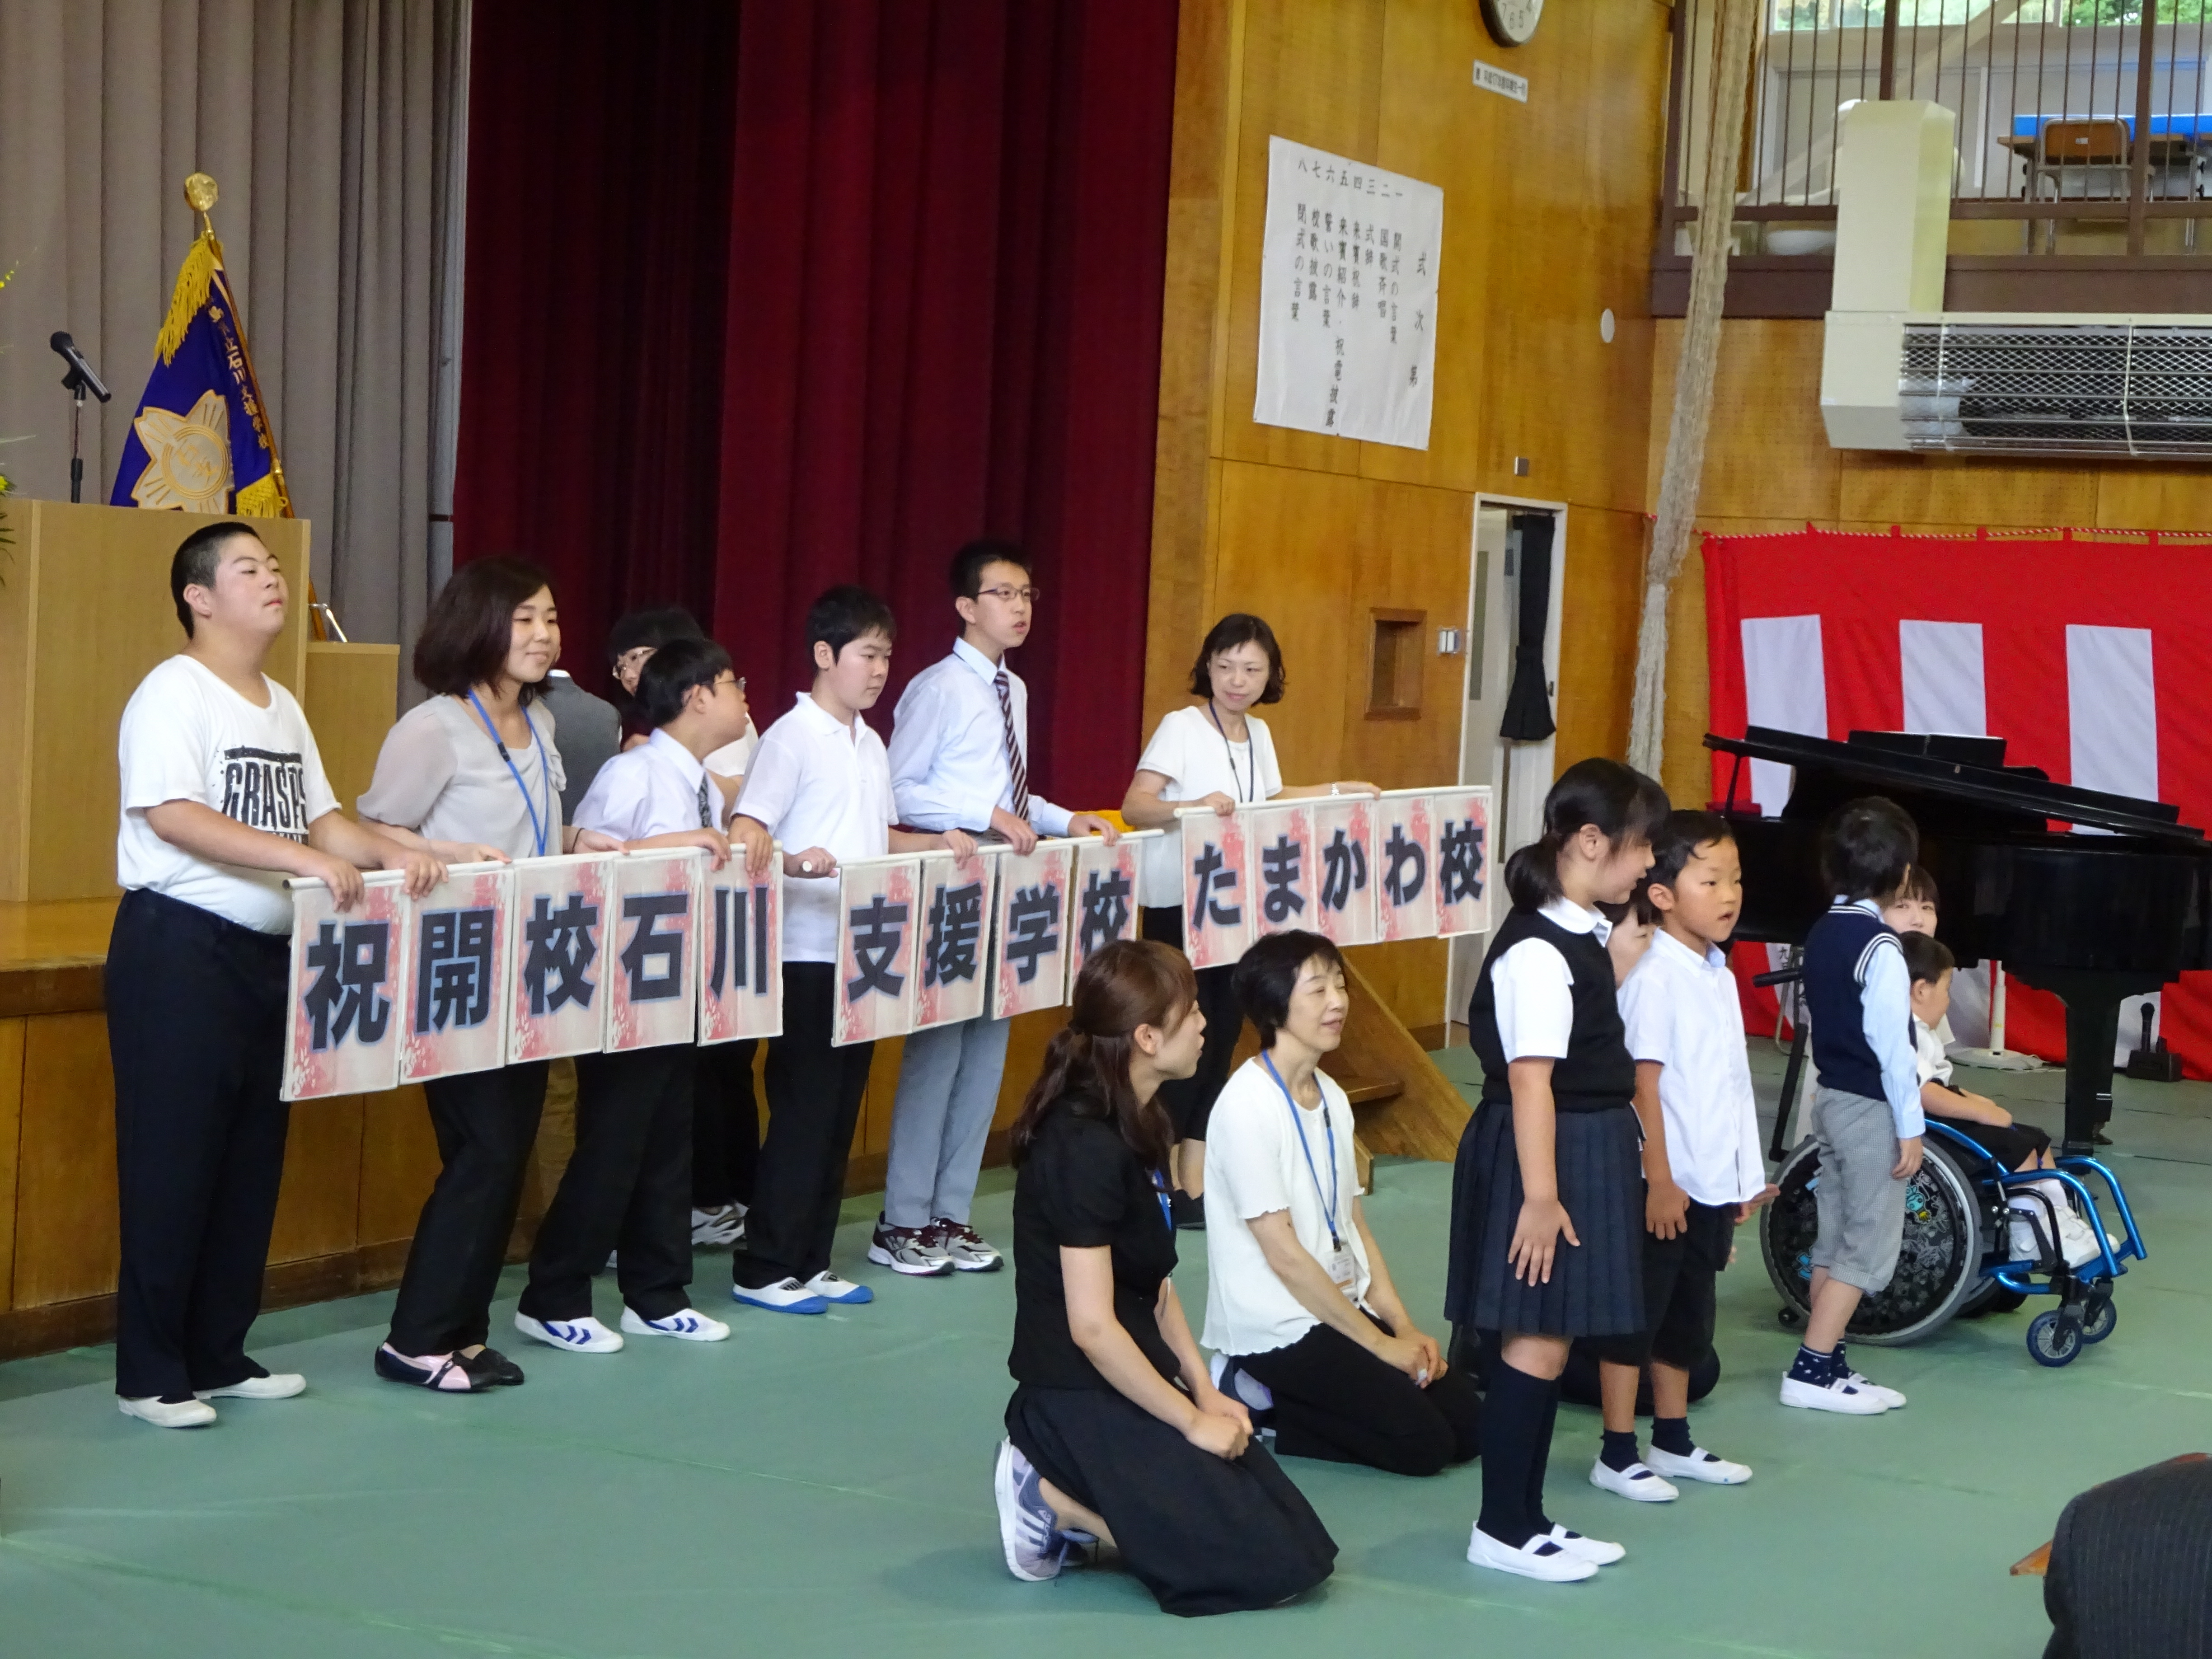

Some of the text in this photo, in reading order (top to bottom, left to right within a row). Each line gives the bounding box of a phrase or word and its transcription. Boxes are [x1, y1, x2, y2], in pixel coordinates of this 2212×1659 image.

[847, 869, 1131, 1003] 支援学校
[1192, 818, 1485, 931] たまかわ校
[302, 885, 769, 1053] 祝開校石川
